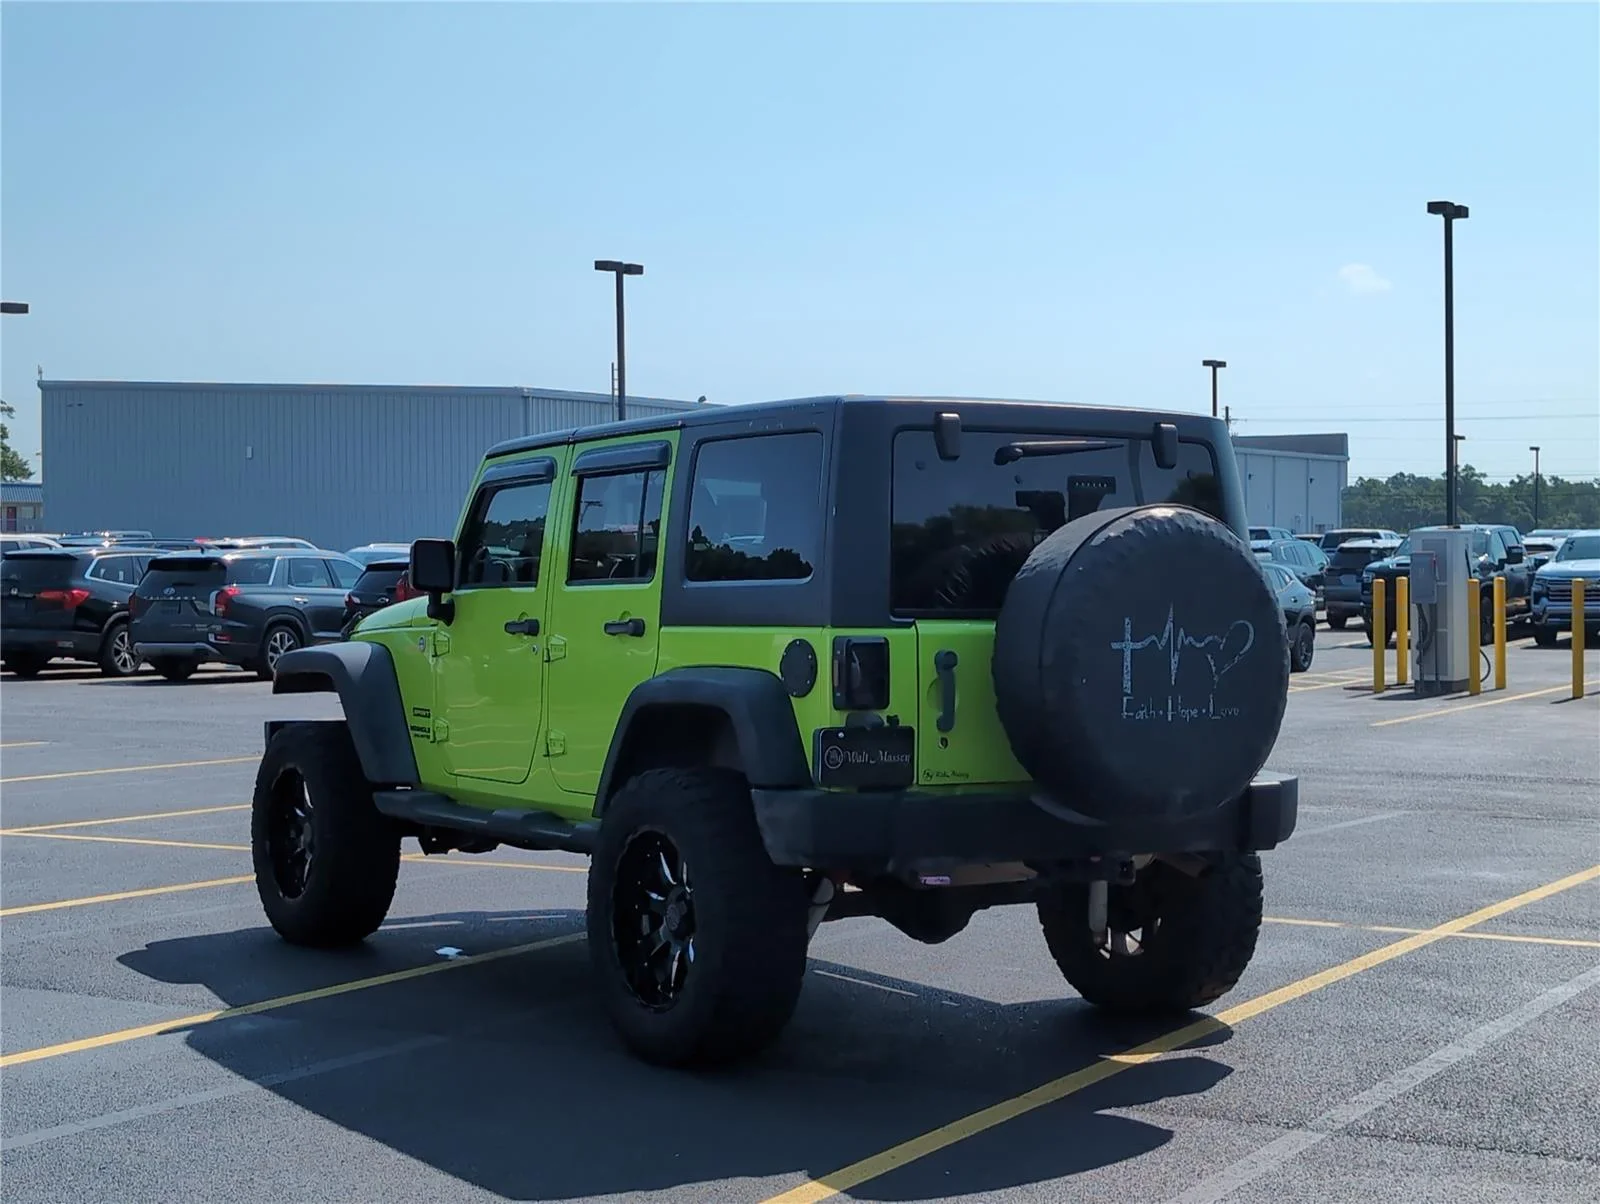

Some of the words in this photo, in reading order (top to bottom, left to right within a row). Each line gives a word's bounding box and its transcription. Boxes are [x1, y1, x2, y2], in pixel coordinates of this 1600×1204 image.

[1121, 696, 1156, 720] Faith
[1167, 694, 1199, 722] Hope
[1208, 692, 1240, 720] Love
[843, 750, 870, 764] Walt
[877, 748, 911, 765] Massey
